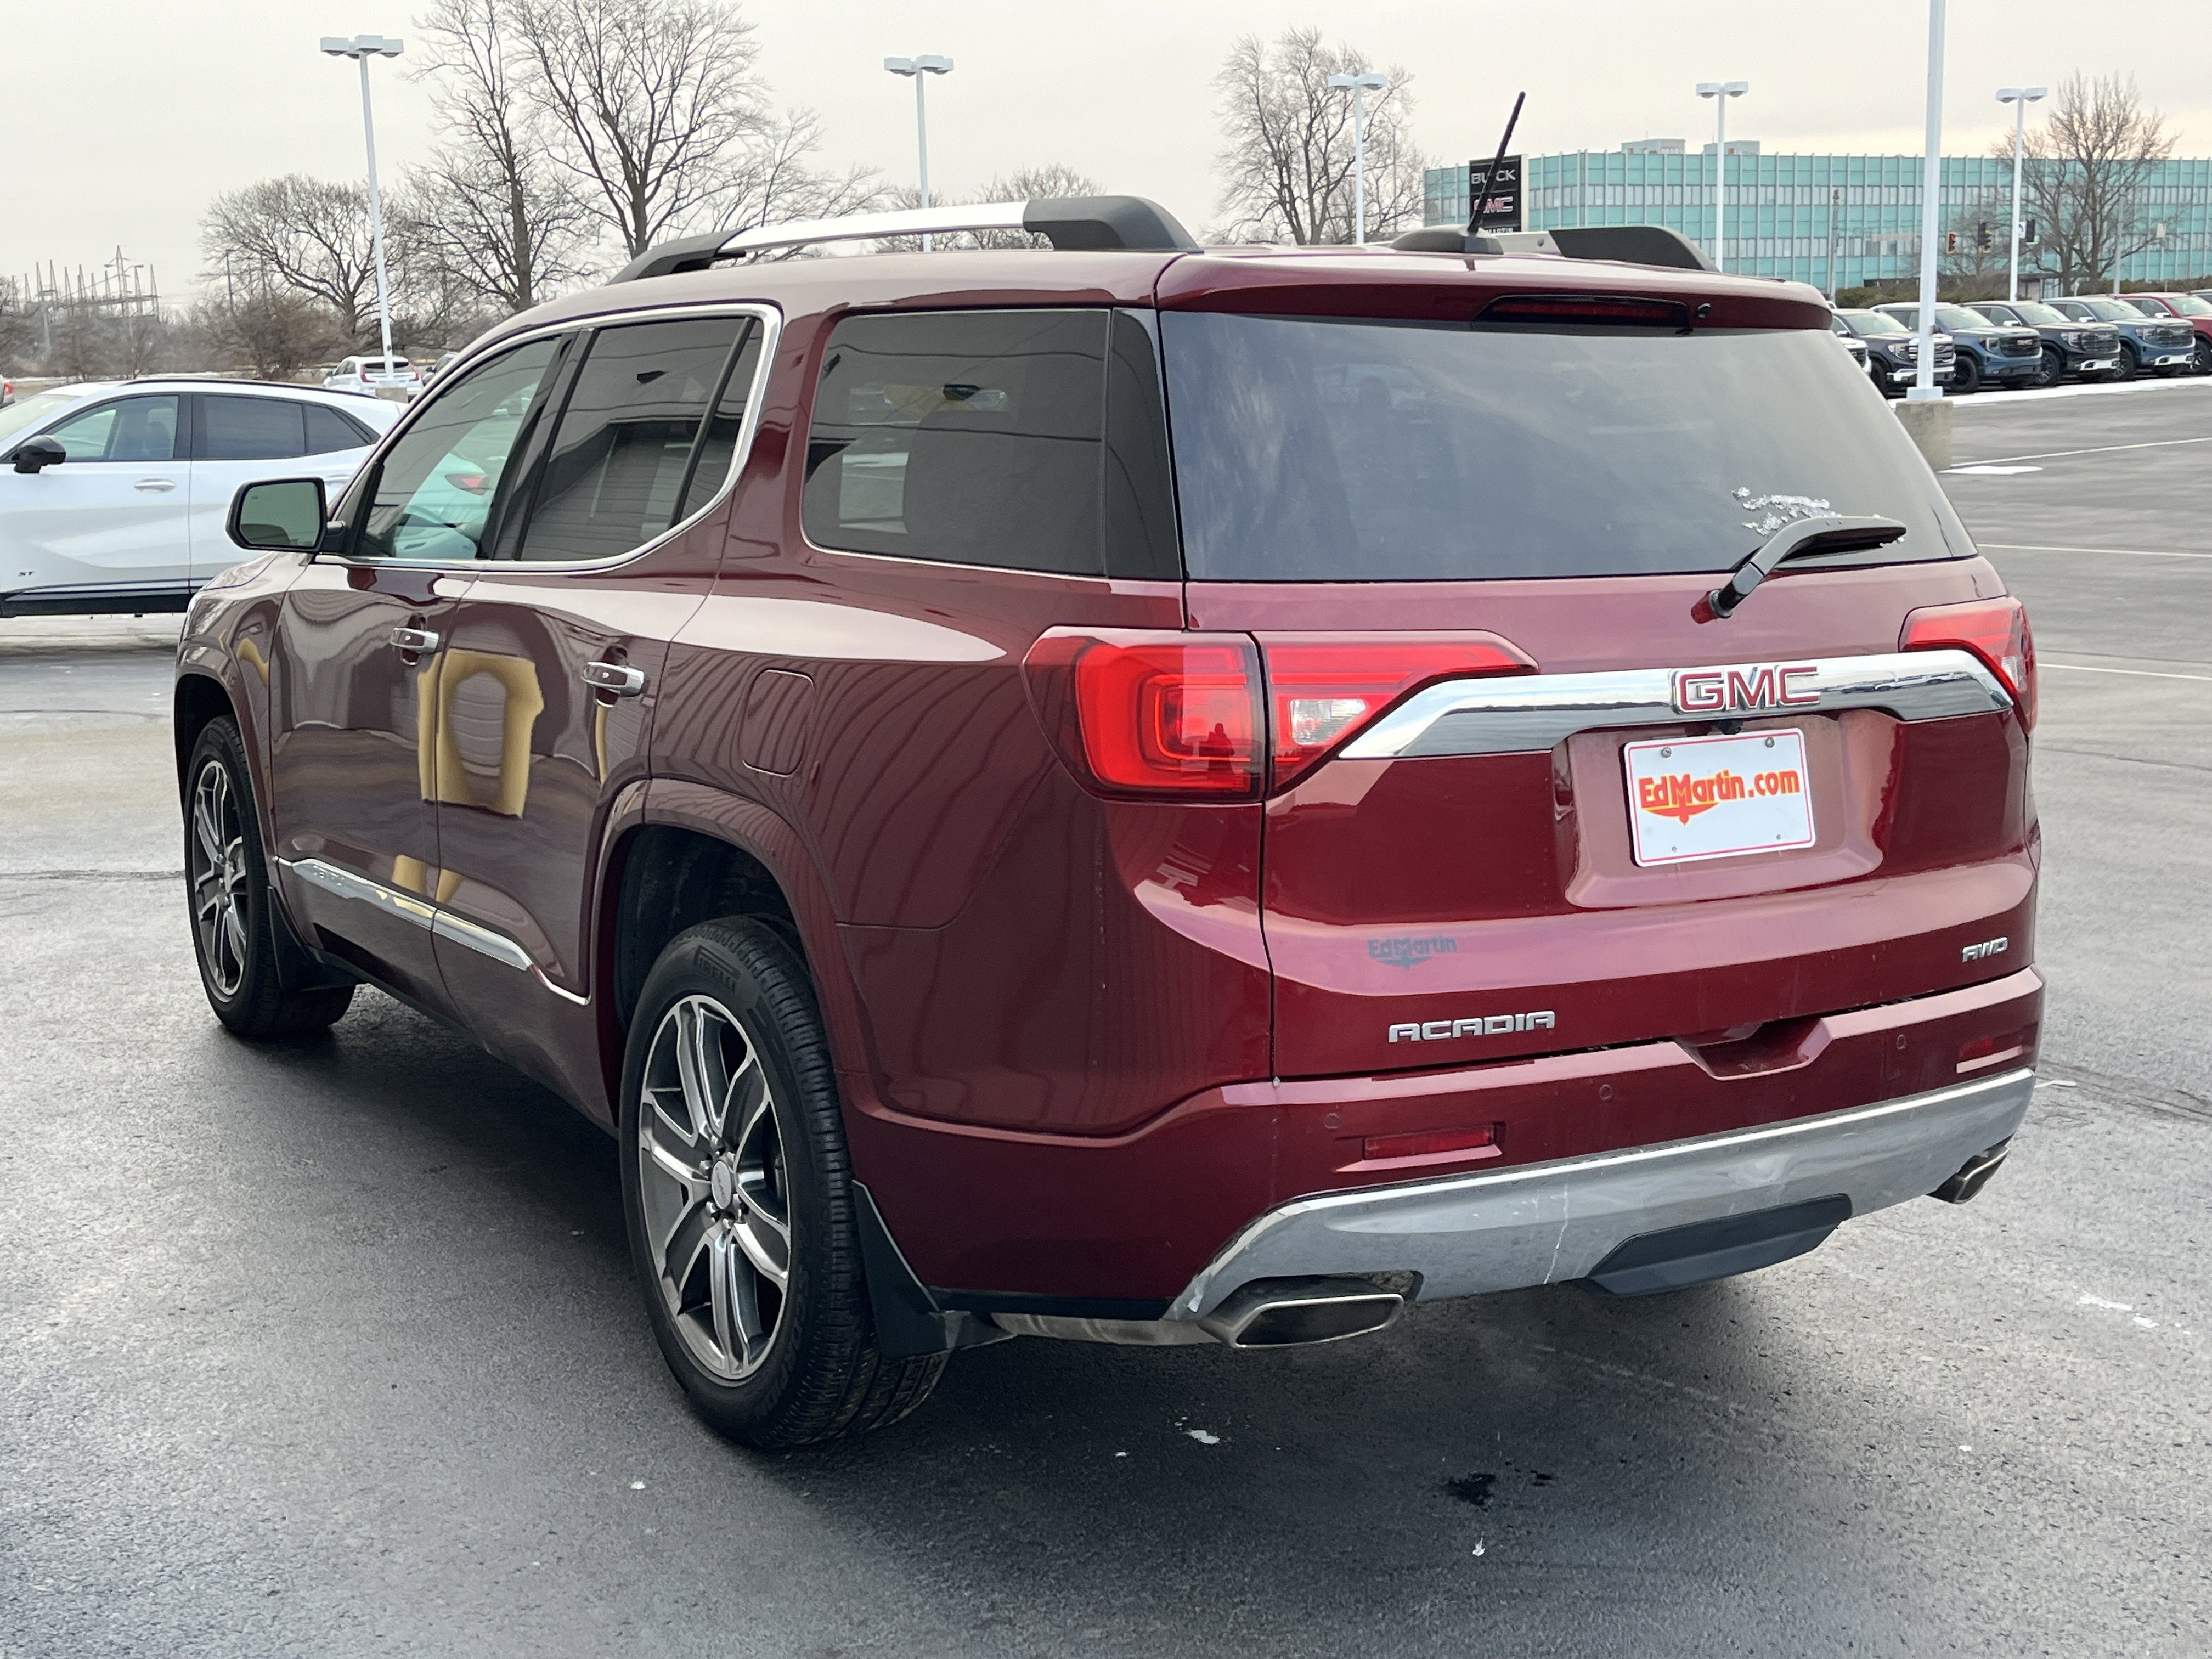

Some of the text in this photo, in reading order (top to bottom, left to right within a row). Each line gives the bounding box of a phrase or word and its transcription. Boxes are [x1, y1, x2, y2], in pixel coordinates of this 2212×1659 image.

[1471, 169, 1516, 184] BUCK
[1675, 665, 1821, 713] GMC
[1962, 936, 2008, 963] AWD
[693, 945, 741, 994] PIRELLI
[1389, 1011, 1555, 1043] ACADIA
